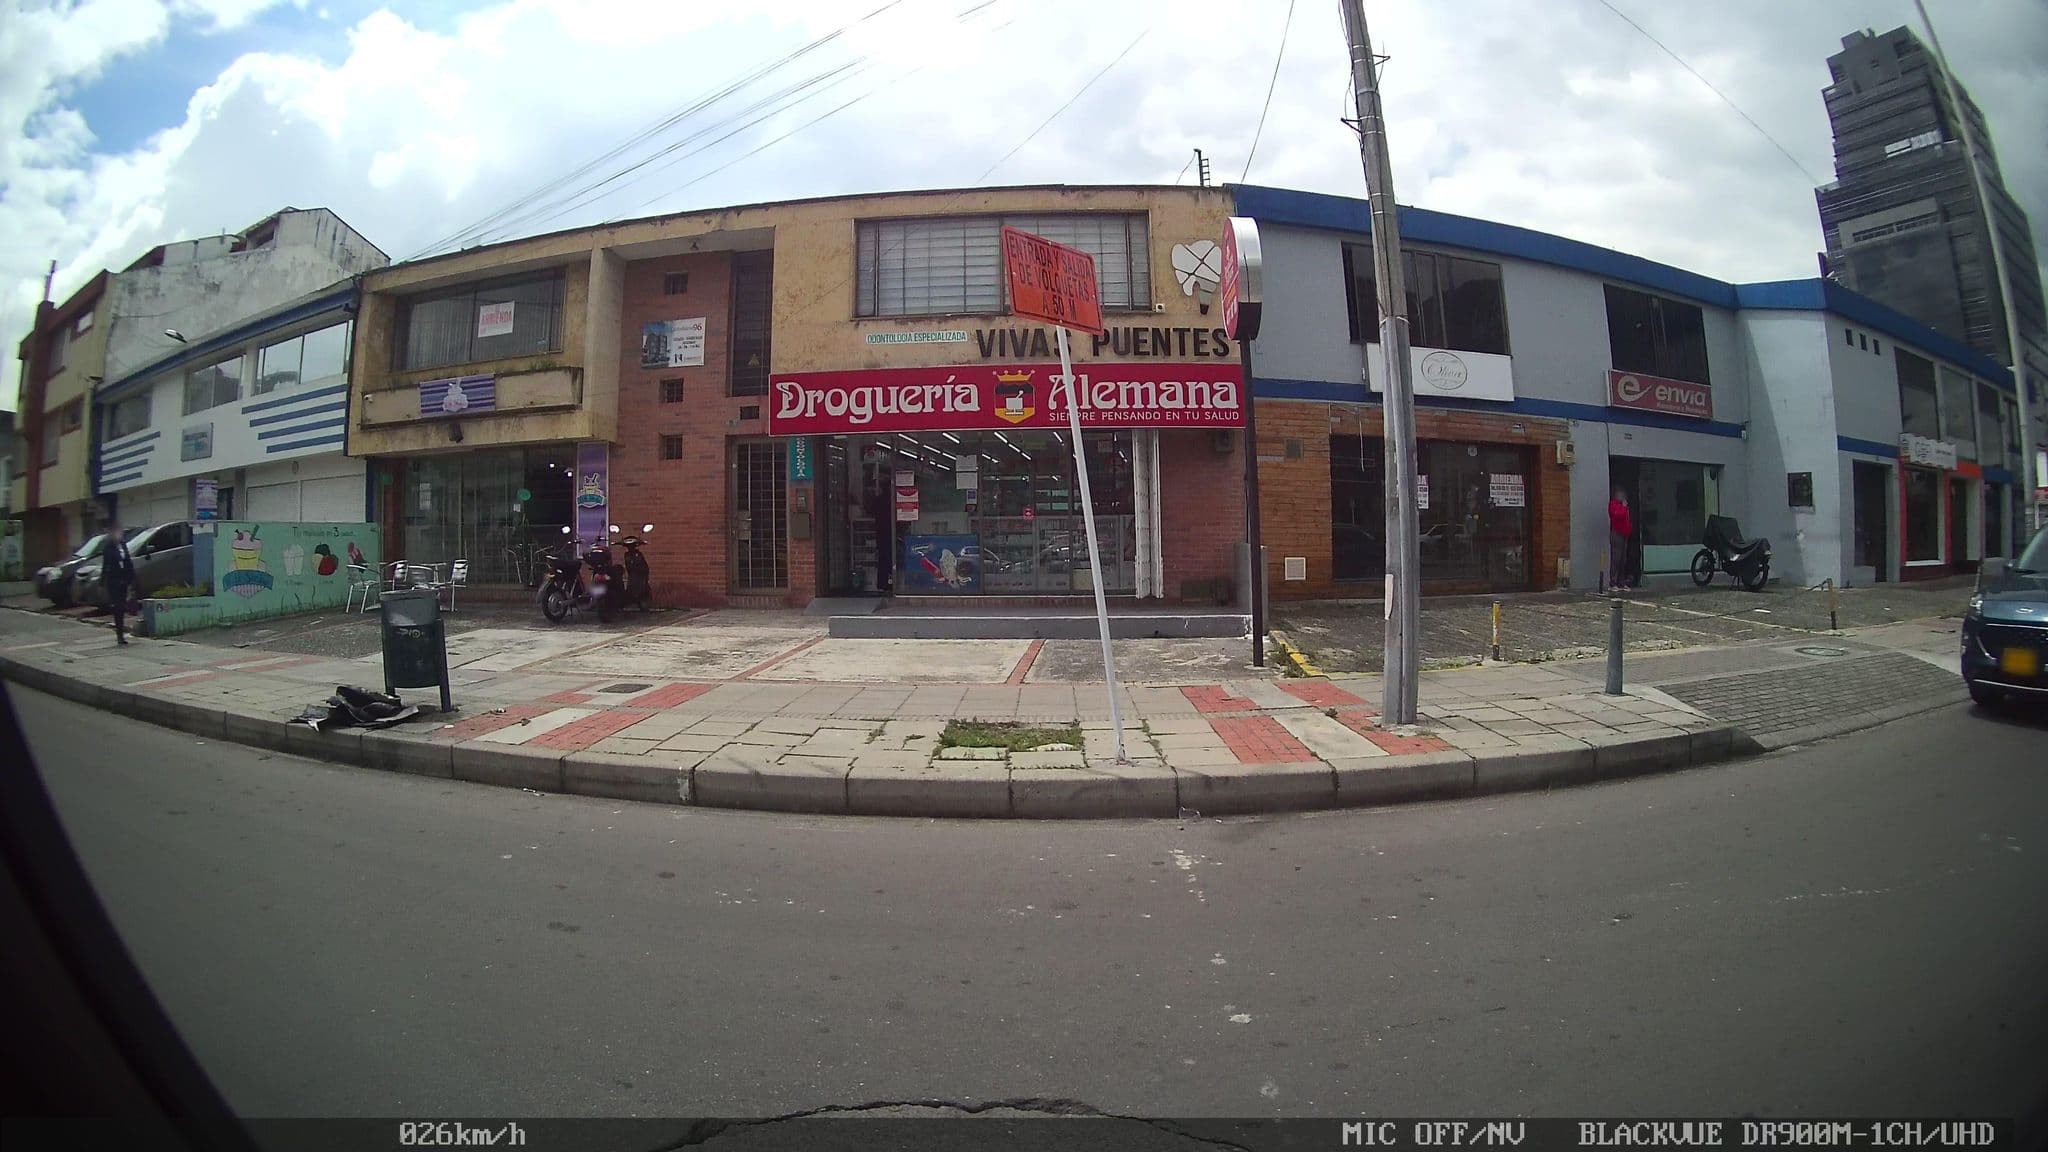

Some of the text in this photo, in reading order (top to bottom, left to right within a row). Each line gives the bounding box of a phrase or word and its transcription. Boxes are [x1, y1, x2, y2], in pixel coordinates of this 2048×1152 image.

[1008, 235, 1092, 280] ENTRADA Y SALIDA
[1018, 262, 1090, 302] DE VOLQUETAS
[1042, 292, 1050, 315] A
[1052, 294, 1065, 317] 50
[914, 331, 966, 342] ESPECIALIZADA
[1092, 327, 1231, 357] PUENTES
[776, 374, 1239, 424] Droguería Alemana
[1102, 411, 1161, 421] PENSANDO
[1165, 411, 1182, 420] EN
[1184, 411, 1200, 420] TU
[1204, 411, 1239, 421] SALUD
